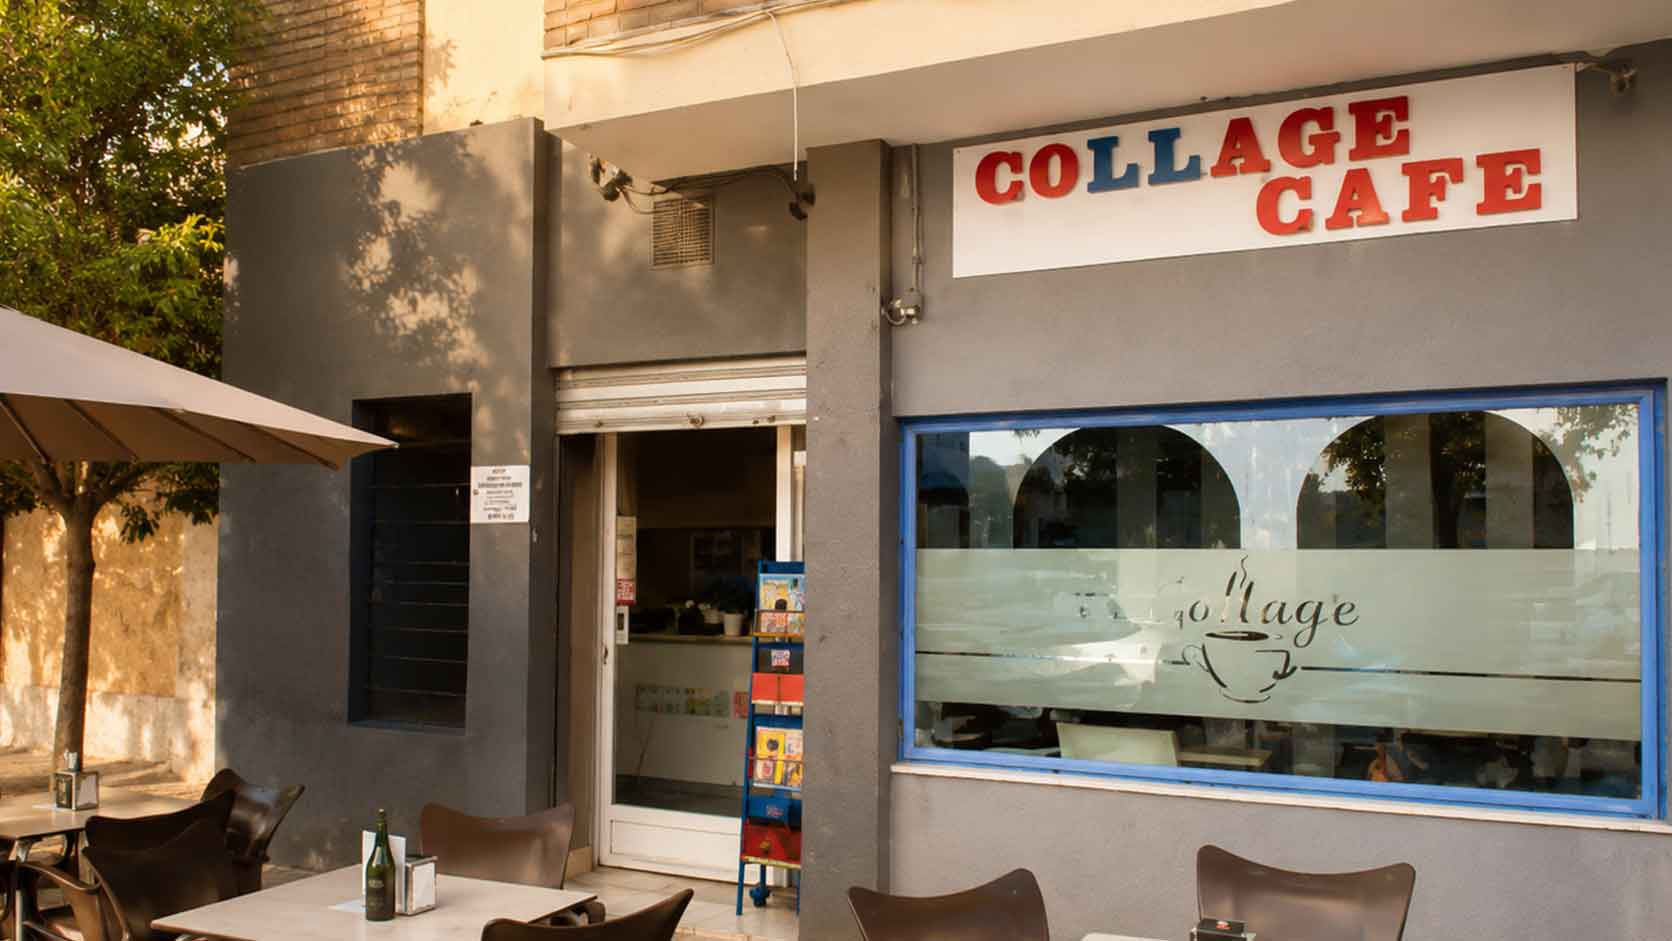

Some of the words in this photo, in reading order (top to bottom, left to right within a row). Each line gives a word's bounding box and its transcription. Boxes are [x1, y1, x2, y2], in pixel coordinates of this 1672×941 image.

[975, 95, 1412, 205] COLLAGE
[1256, 148, 1543, 236] CAFE
[1160, 570, 1360, 648] ollage
